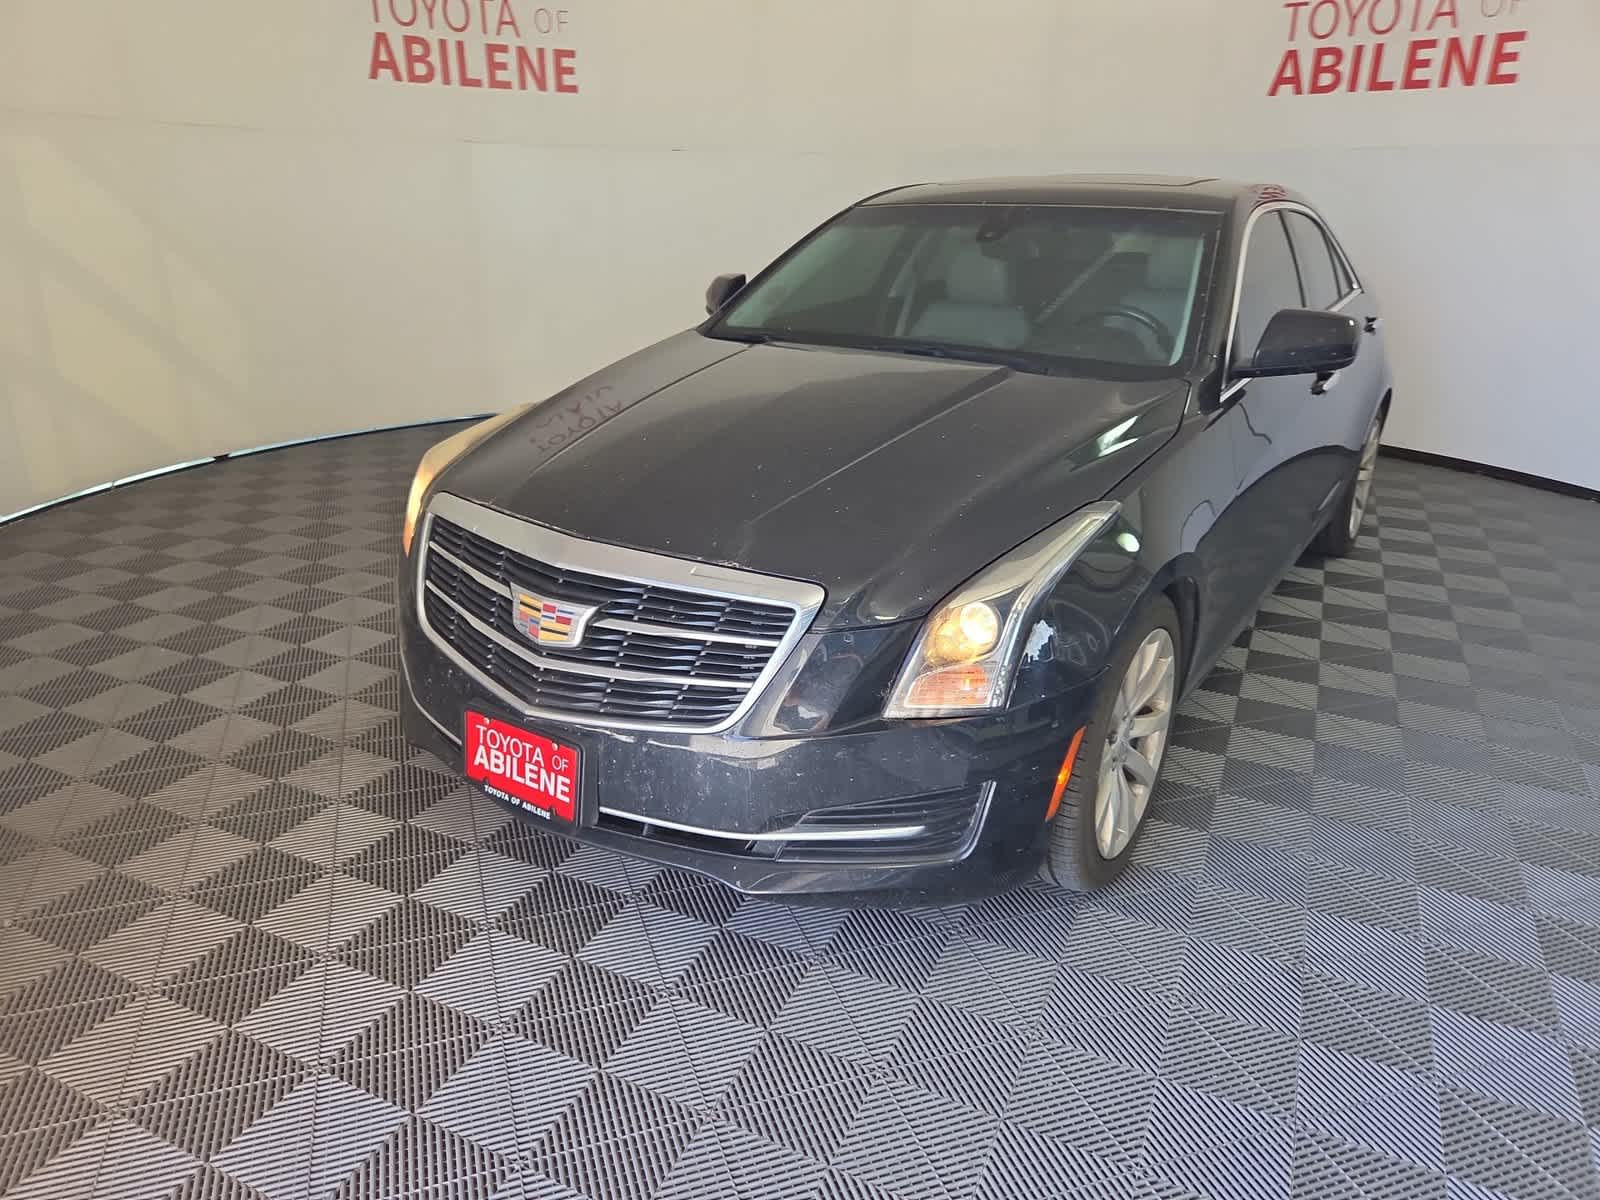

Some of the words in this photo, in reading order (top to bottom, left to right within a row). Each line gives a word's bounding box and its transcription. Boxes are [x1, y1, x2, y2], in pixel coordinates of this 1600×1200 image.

[534, 8, 569, 34] OF
[1283, 0, 1458, 41] TOYOTA
[368, 31, 578, 94] ABILENE
[1266, 30, 1528, 96] ABILENE
[475, 724, 545, 767] TOYOTA
[551, 755, 569, 772] OF
[473, 744, 571, 803] ABILENE
[484, 784, 509, 802] TOYOTA
[511, 796, 520, 806] OF
[522, 801, 551, 820] ABILENE
